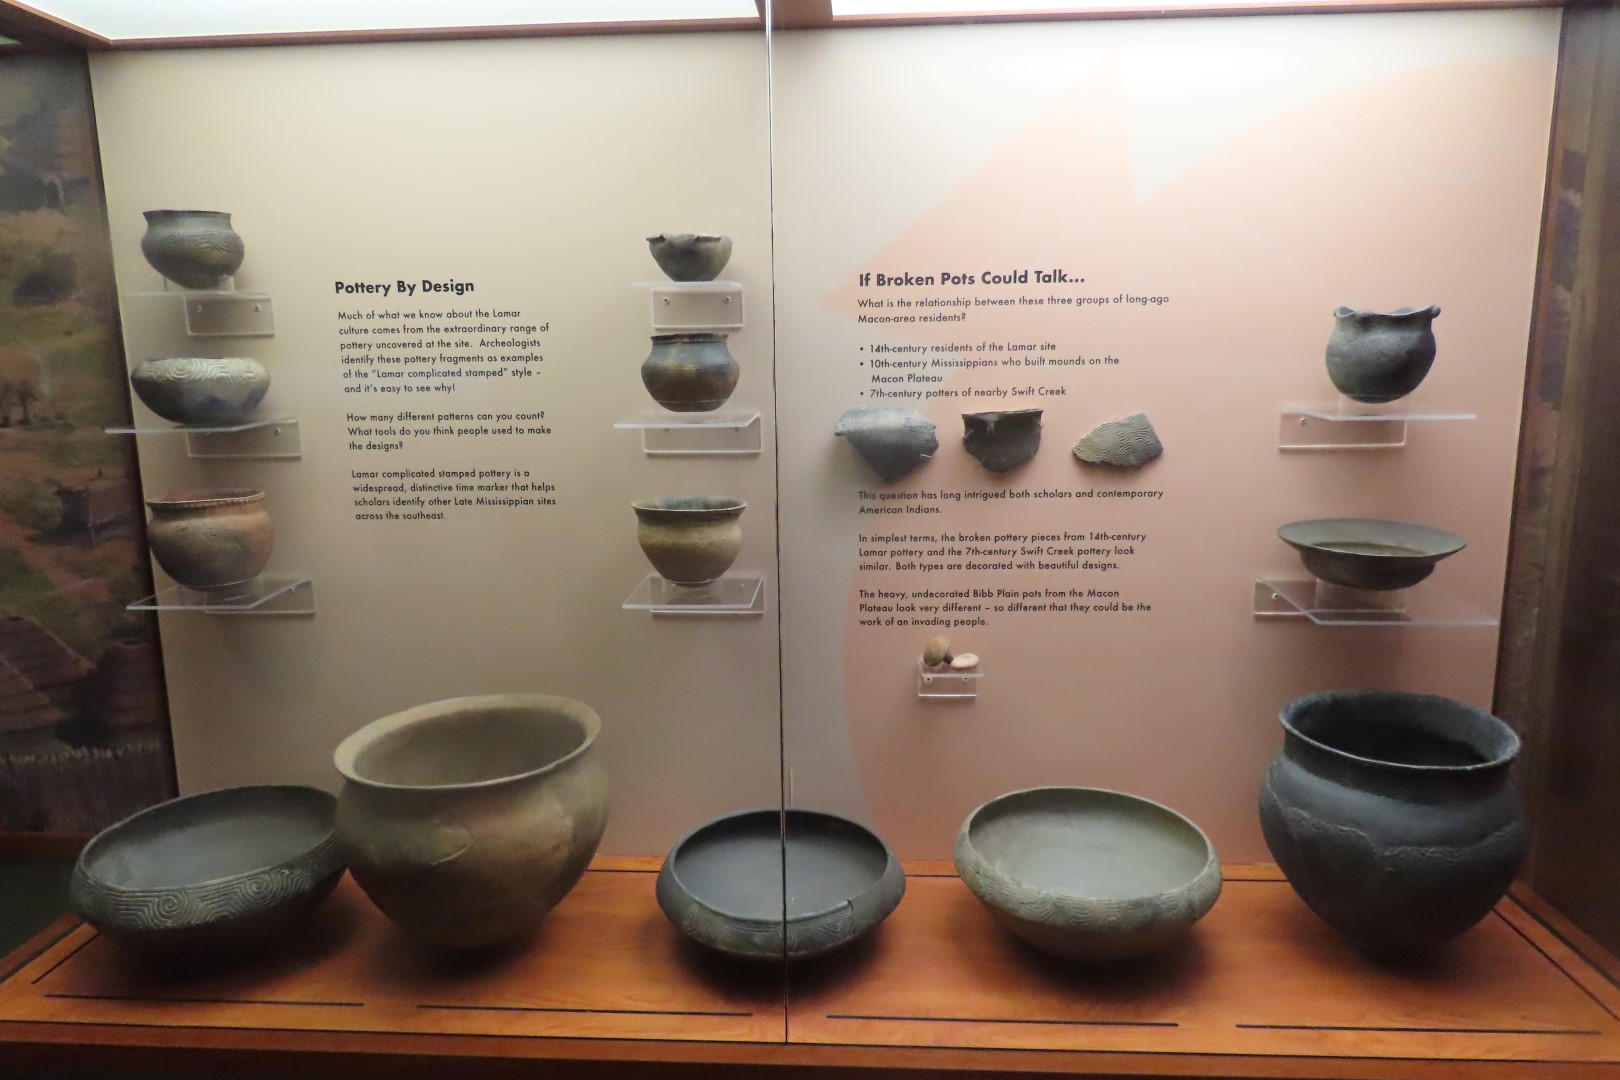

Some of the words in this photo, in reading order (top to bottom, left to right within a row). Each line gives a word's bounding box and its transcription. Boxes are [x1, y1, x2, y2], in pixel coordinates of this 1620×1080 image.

[859, 272, 871, 287] If
[876, 272, 935, 287] Broken
[941, 272, 976, 286] Pots
[981, 269, 1029, 285] Could
[335, 281, 392, 297] Pottery
[396, 280, 417, 297] By
[422, 279, 474, 296] Design
[857, 298, 884, 308] What
[887, 299, 894, 308] is
[897, 297, 912, 308] the
[915, 297, 971, 309] relationship
[975, 297, 1016, 306] between
[1019, 295, 1044, 306] these
[1047, 295, 1073, 305] three
[1076, 297, 1110, 307] groups
[1113, 293, 1123, 304] of
[1126, 294, 1170, 306] long-ago
[338, 310, 363, 320] Much
[366, 310, 375, 320] of
[377, 310, 400, 320] what
[418, 309, 443, 319] know
[446, 309, 473, 319] about
[475, 308, 490, 318] the
[492, 309, 521, 318] Lamar
[858, 314, 916, 324] Macon-area
[919, 312, 966, 323] residents?
[339, 325, 369, 335] culture
[372, 327, 401, 335] comes
[403, 324, 424, 334] from
[426, 324, 441, 334] the
[443, 323, 507, 335] extraordinary
[510, 325, 537, 335] range
[540, 322, 550, 332] of
[340, 341, 373, 352] pottery
[376, 339, 423, 349] uncovered
[425, 340, 435, 349] at
[437, 339, 452, 348] the
[455, 339, 473, 348] site.
[479, 337, 541, 350] Archeologists
[870, 343, 928, 355] 14th-century
[931, 342, 973, 353] residents
[976, 342, 986, 352] of
[989, 341, 1004, 352] the
[1007, 342, 1037, 352] Lamar
[1040, 341, 1056, 351] site
[341, 354, 375, 366] identify
[377, 354, 401, 364] these
[404, 355, 437, 366] pottery
[439, 353, 484, 365] fragments
[500, 352, 544, 365] examples
[870, 358, 928, 370] 10th-century
[931, 358, 998, 370] Mississippians
[1001, 356, 1022, 366] who
[1025, 356, 1046, 366] built
[1049, 355, 1086, 366] mounds
[1089, 358, 1101, 366] on
[1104, 355, 1120, 365] the
[871, 374, 904, 383] Macon
[907, 373, 943, 383] Plateau
[344, 383, 362, 393] and
[364, 384, 378, 393] it's
[380, 386, 402, 395] easy
[403, 385, 413, 393] to
[433, 382, 455, 395] why!
[870, 388, 923, 400] 7th-century
[926, 389, 959, 400] potters
[961, 386, 972, 397] of
[974, 386, 1008, 399] nearby
[1011, 386, 1035, 396] Swift
[1038, 386, 1066, 396] Creek
[347, 413, 367, 422] How
[370, 415, 394, 424] many
[397, 411, 435, 421] different
[437, 413, 474, 423] patterns
[496, 414, 513, 423] you
[515, 411, 545, 420] count?
[347, 426, 372, 436] What
[374, 426, 397, 436] tools
[399, 426, 411, 436] do
[413, 429, 431, 438] you
[433, 425, 455, 435] think
[457, 425, 489, 437] people
[491, 425, 513, 435] used
[515, 426, 525, 435] to
[527, 425, 552, 435] make
[349, 441, 363, 450] the
[366, 440, 403, 453] designs?
[351, 470, 379, 479] Lamar
[382, 468, 436, 480] complicated
[438, 468, 476, 480] stamped
[478, 469, 512, 480] pottery
[514, 468, 521, 477] is
[352, 482, 407, 495] widespread,
[410, 482, 453, 492] distinctive
[456, 483, 475, 492] time
[477, 482, 509, 492] marker
[511, 482, 529, 492] that
[531, 482, 555, 494] helps
[354, 497, 390, 507] scholars
[393, 496, 426, 508] identify
[428, 496, 452, 506] other
[454, 497, 473, 506] Late
[476, 496, 534, 508] Mississippian
[537, 496, 556, 506] sites
[859, 534, 868, 542] In
[870, 533, 907, 545] simplest
[910, 534, 938, 544] terms,
[941, 532, 956, 542] the
[958, 532, 991, 542] broken
[994, 533, 1028, 544] pottery
[1031, 532, 1061, 544] pieces
[1063, 531, 1085, 541] from
[1089, 531, 1147, 543] 14th-century
[859, 548, 888, 557] Lamar
[890, 549, 924, 559] pottery
[926, 546, 945, 557] and
[947, 546, 962, 556] the
[965, 546, 1018, 558] 7th-century
[1020, 546, 1044, 556] Swift
[1046, 546, 1074, 556] Creek
[1077, 547, 1112, 558] pottery
[1114, 545, 1135, 555] look
[859, 561, 891, 571] similar.
[895, 561, 916, 571] Both
[919, 563, 944, 573] types
[965, 560, 1013, 570] decorated
[1015, 560, 1035, 570] with
[1038, 560, 1079, 570] beautiful
[1082, 560, 1120, 572] designs.
[859, 589, 875, 599] The
[878, 589, 908, 601] heavy,
[911, 588, 970, 598] undecorated
[973, 588, 994, 598] Bibb
[997, 588, 1019, 598] Plain
[1022, 590, 1042, 600] pots
[1045, 588, 1066, 598] from
[1069, 588, 1084, 598] the
[1087, 589, 1120, 598] Macon
[859, 616, 882, 626] work
[884, 616, 895, 626] of
[911, 616, 951, 628] invading
[953, 616, 989, 628] people.
